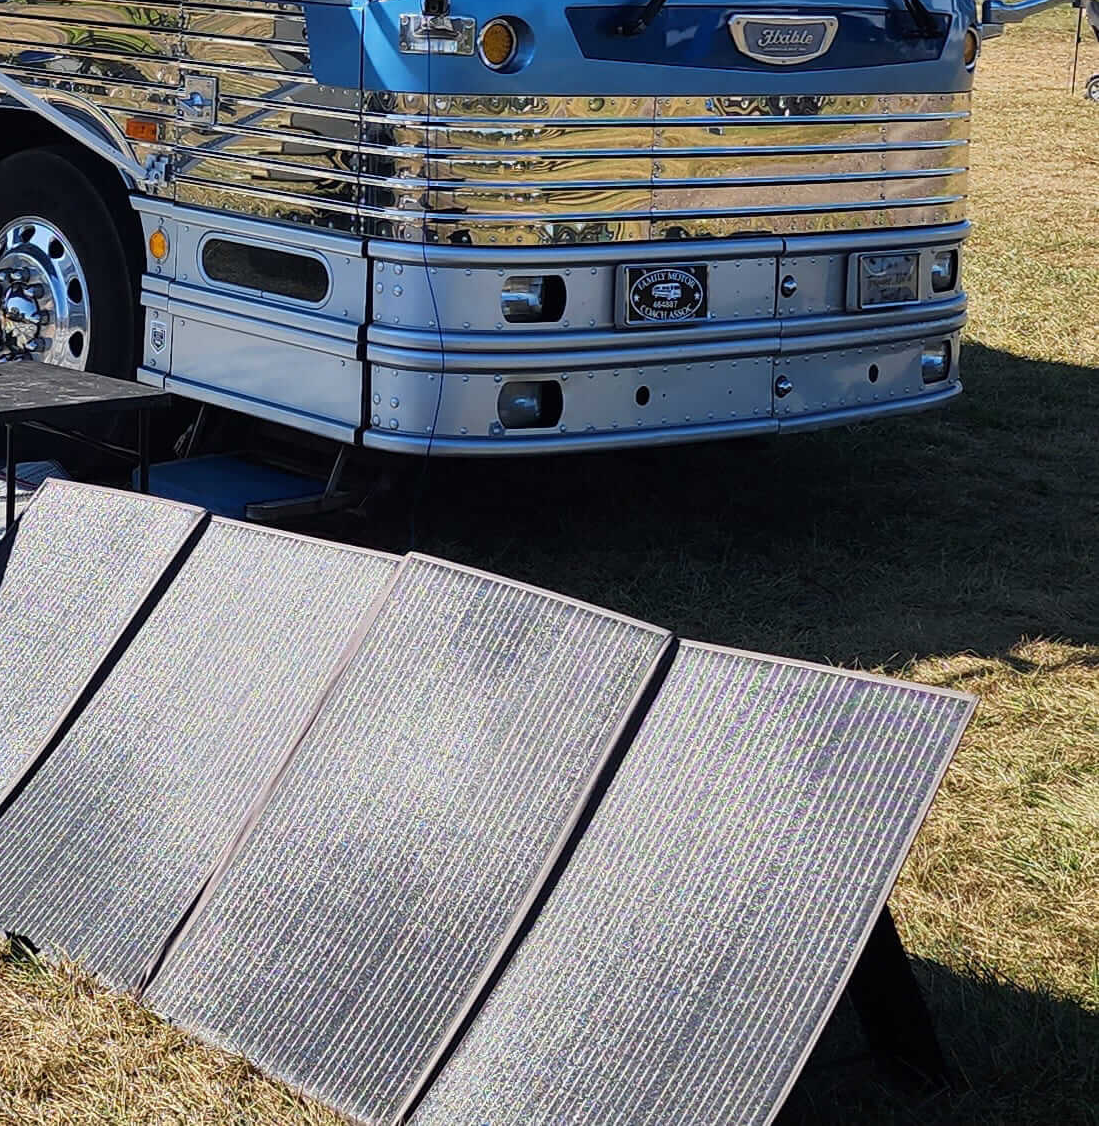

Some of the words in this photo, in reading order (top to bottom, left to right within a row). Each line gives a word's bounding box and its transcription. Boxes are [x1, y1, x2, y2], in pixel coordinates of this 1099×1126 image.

[758, 29, 814, 47] Flxible
[638, 274, 665, 290] FAMILY
[668, 272, 696, 289] MOTOR
[640, 304, 668, 320] COACH
[669, 303, 692, 319] ASSOC
